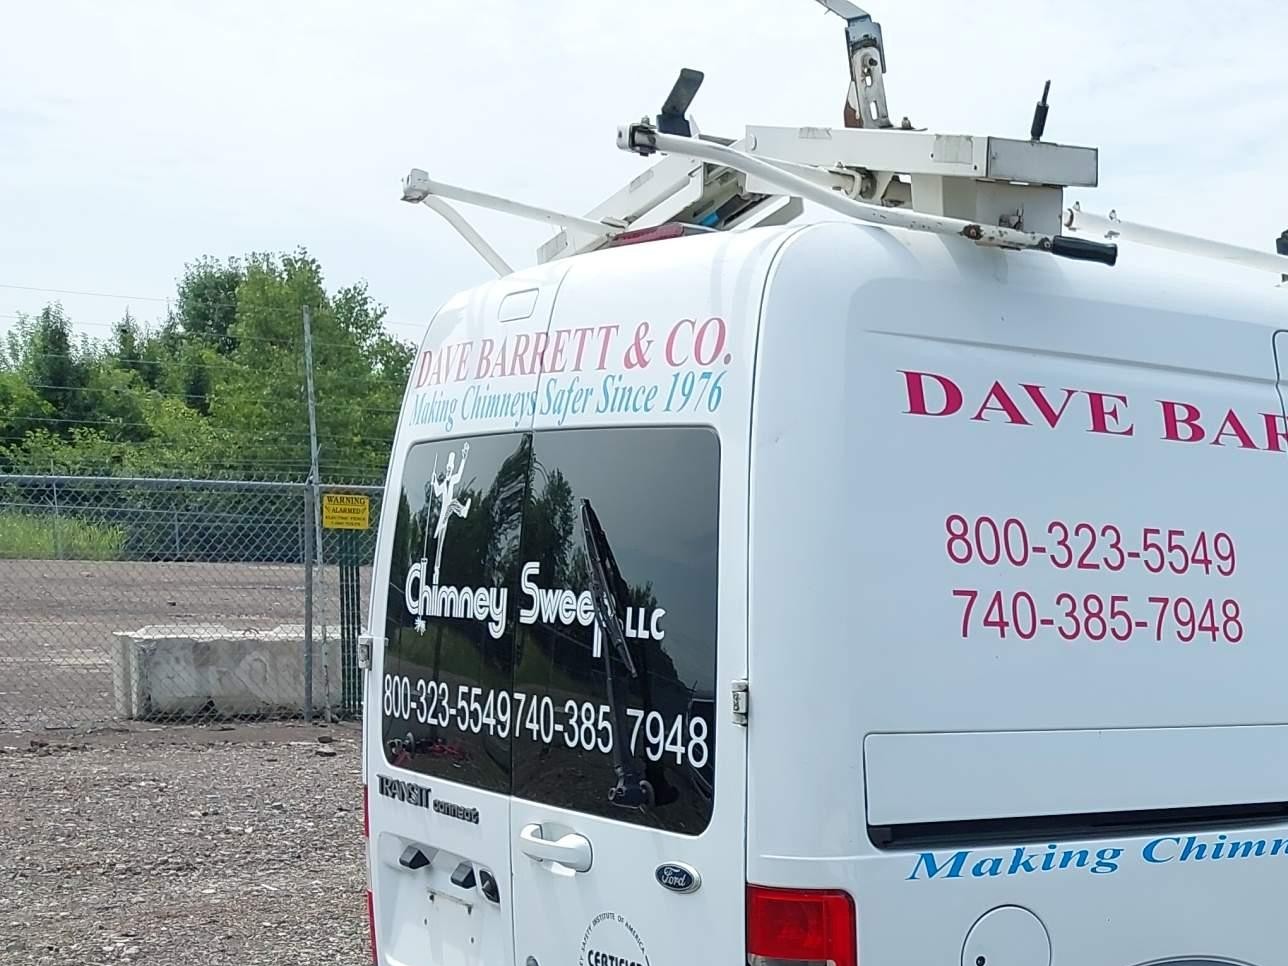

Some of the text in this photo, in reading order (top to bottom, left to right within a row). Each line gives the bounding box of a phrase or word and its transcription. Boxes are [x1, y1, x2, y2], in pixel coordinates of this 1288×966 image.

[415, 317, 732, 389] DAVE BARRETT & CO.
[410, 371, 723, 432] Making Chimneys Safer Since 1976
[896, 369, 1134, 437] DAVE
[326, 496, 366, 505] WARNING
[945, 514, 1237, 577] 800-323-5549
[405, 559, 508, 639] Chimney
[625, 606, 667, 641] LLC
[952, 589, 1244, 643] 740-385-7948
[384, 673, 511, 738] 800-323-5549
[376, 774, 432, 808] TRANSIT
[661, 866, 688, 887] Ford
[905, 843, 1124, 881] Making
